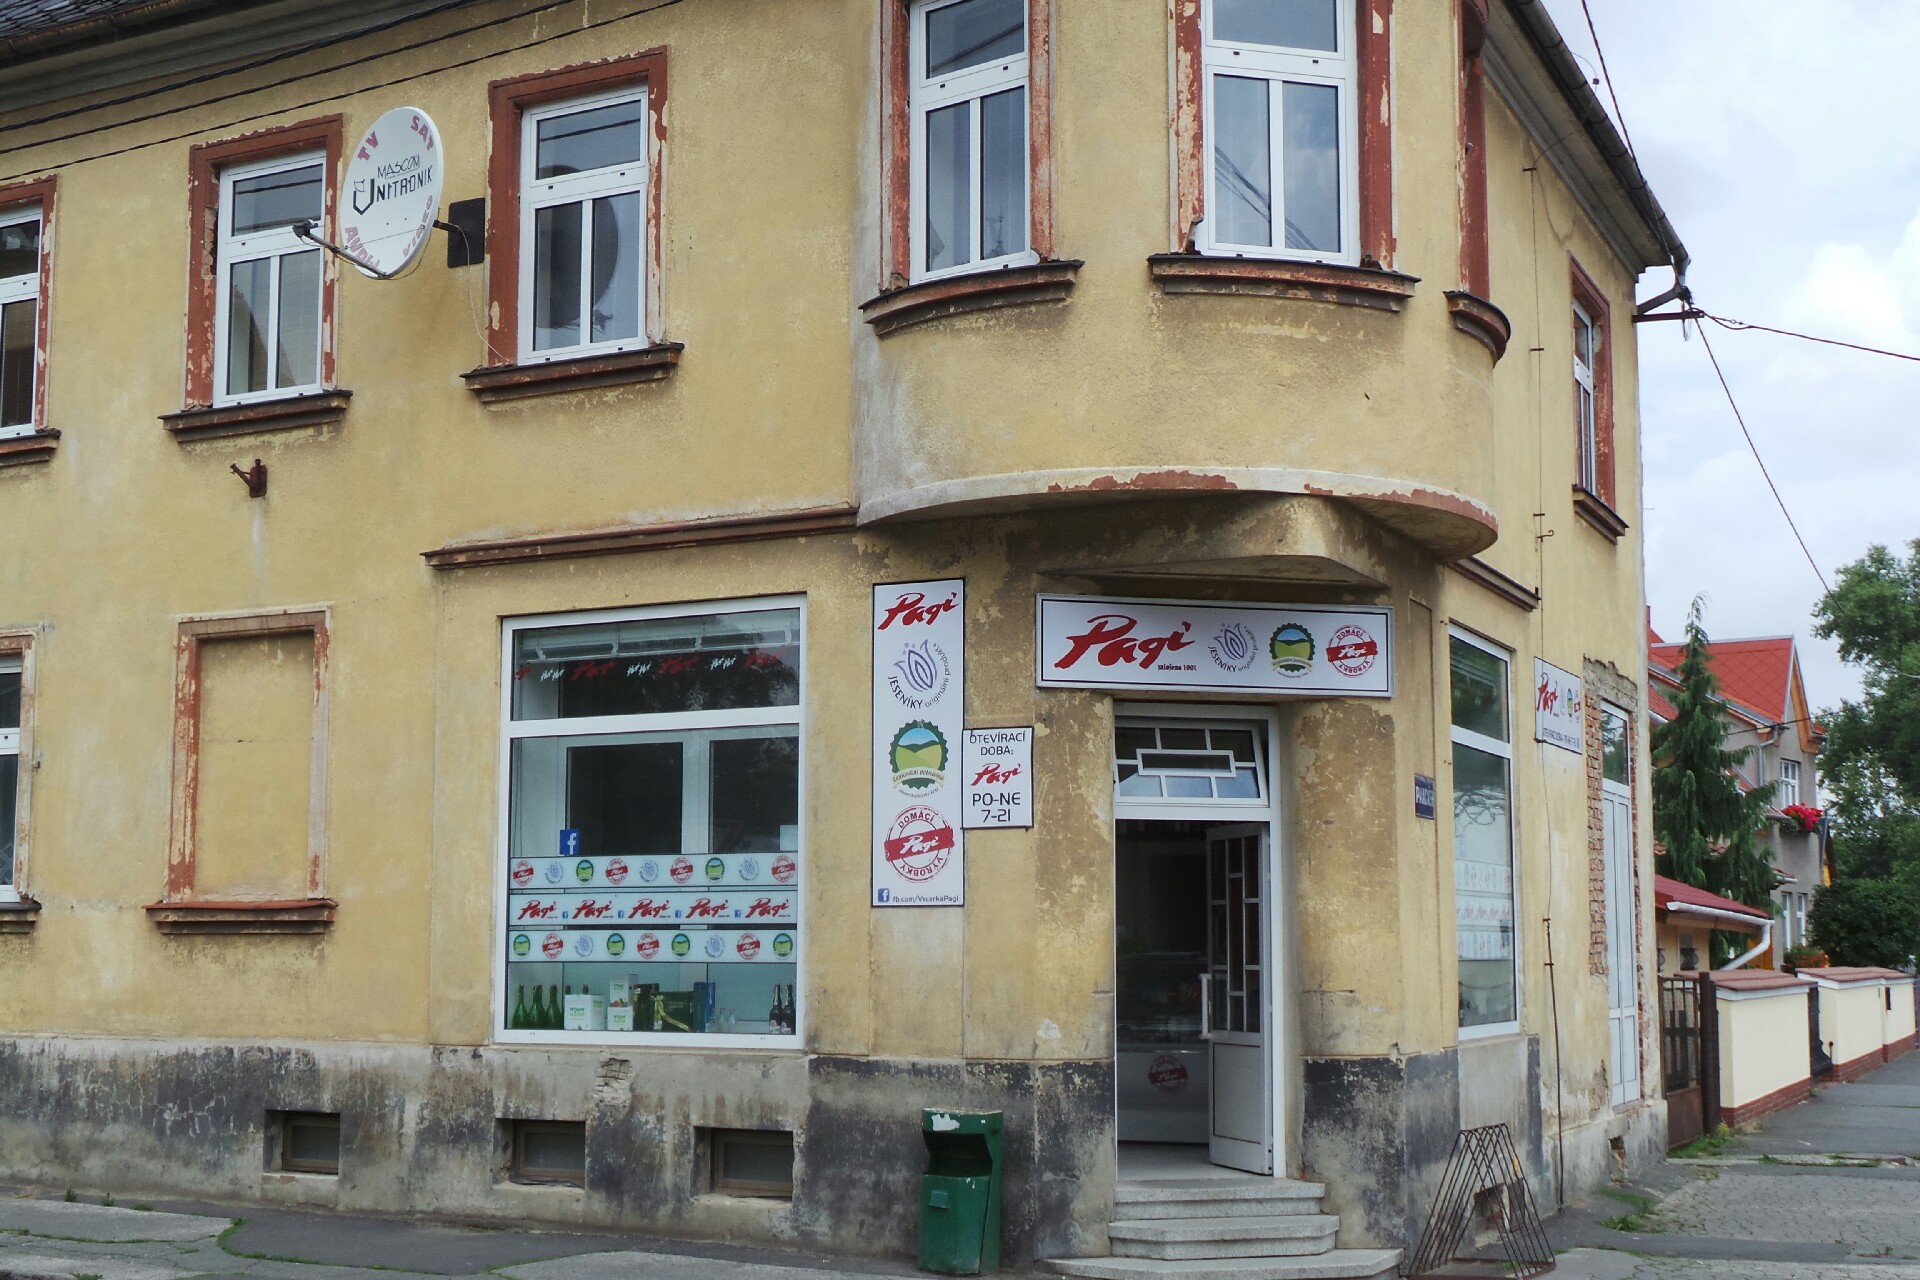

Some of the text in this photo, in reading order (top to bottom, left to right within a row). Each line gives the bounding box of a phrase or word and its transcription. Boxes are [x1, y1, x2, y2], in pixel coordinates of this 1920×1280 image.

[410, 115, 434, 151] SAT
[357, 130, 379, 161] TV
[377, 153, 420, 180] MASCOM
[402, 195, 433, 258] VIDEO
[878, 592, 959, 631] Pagi
[1053, 614, 1195, 669] Pagi
[1336, 628, 1364, 641] DOMÁCÍ
[1208, 645, 1237, 673] JESENÍKY
[888, 676, 923, 709] JESENÍKY
[969, 730, 1026, 744] OTEVÍRACÍ
[980, 746, 1014, 756] DOBA:
[970, 762, 1023, 786] Pagi
[972, 792, 1021, 806] PO-NE
[898, 810, 934, 829] DOMÁCÍ
[981, 808, 1011, 822] 7-21
[900, 834, 940, 854] Pagi
[900, 856, 944, 876] VÝROBKY
[517, 899, 557, 920] Pagi
[571, 898, 613, 919] Pagi
[627, 898, 670, 919] Pagi
[684, 897, 729, 918] Pagi
[744, 897, 789, 918] Pagi
